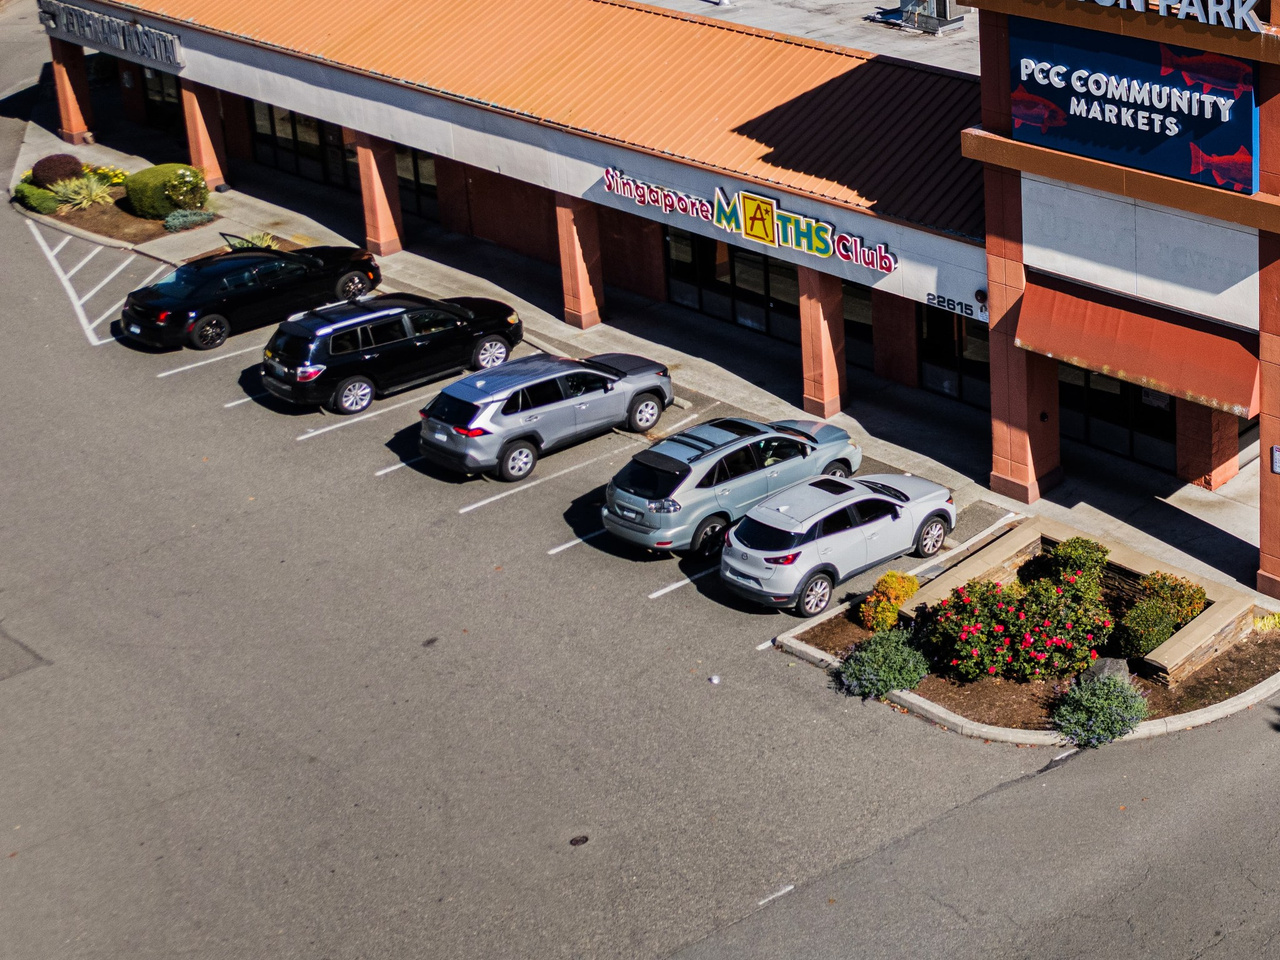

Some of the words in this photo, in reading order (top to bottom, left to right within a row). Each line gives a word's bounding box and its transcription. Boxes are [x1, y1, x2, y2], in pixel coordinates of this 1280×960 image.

[1020, 58, 1070, 88] PCC
[1071, 69, 1235, 122] COMMUNITY
[1069, 96, 1182, 137] MARKETS
[603, 167, 713, 221] Singapore
[713, 186, 836, 258] MATHS
[835, 233, 898, 274] Club
[926, 292, 974, 316] 22615
